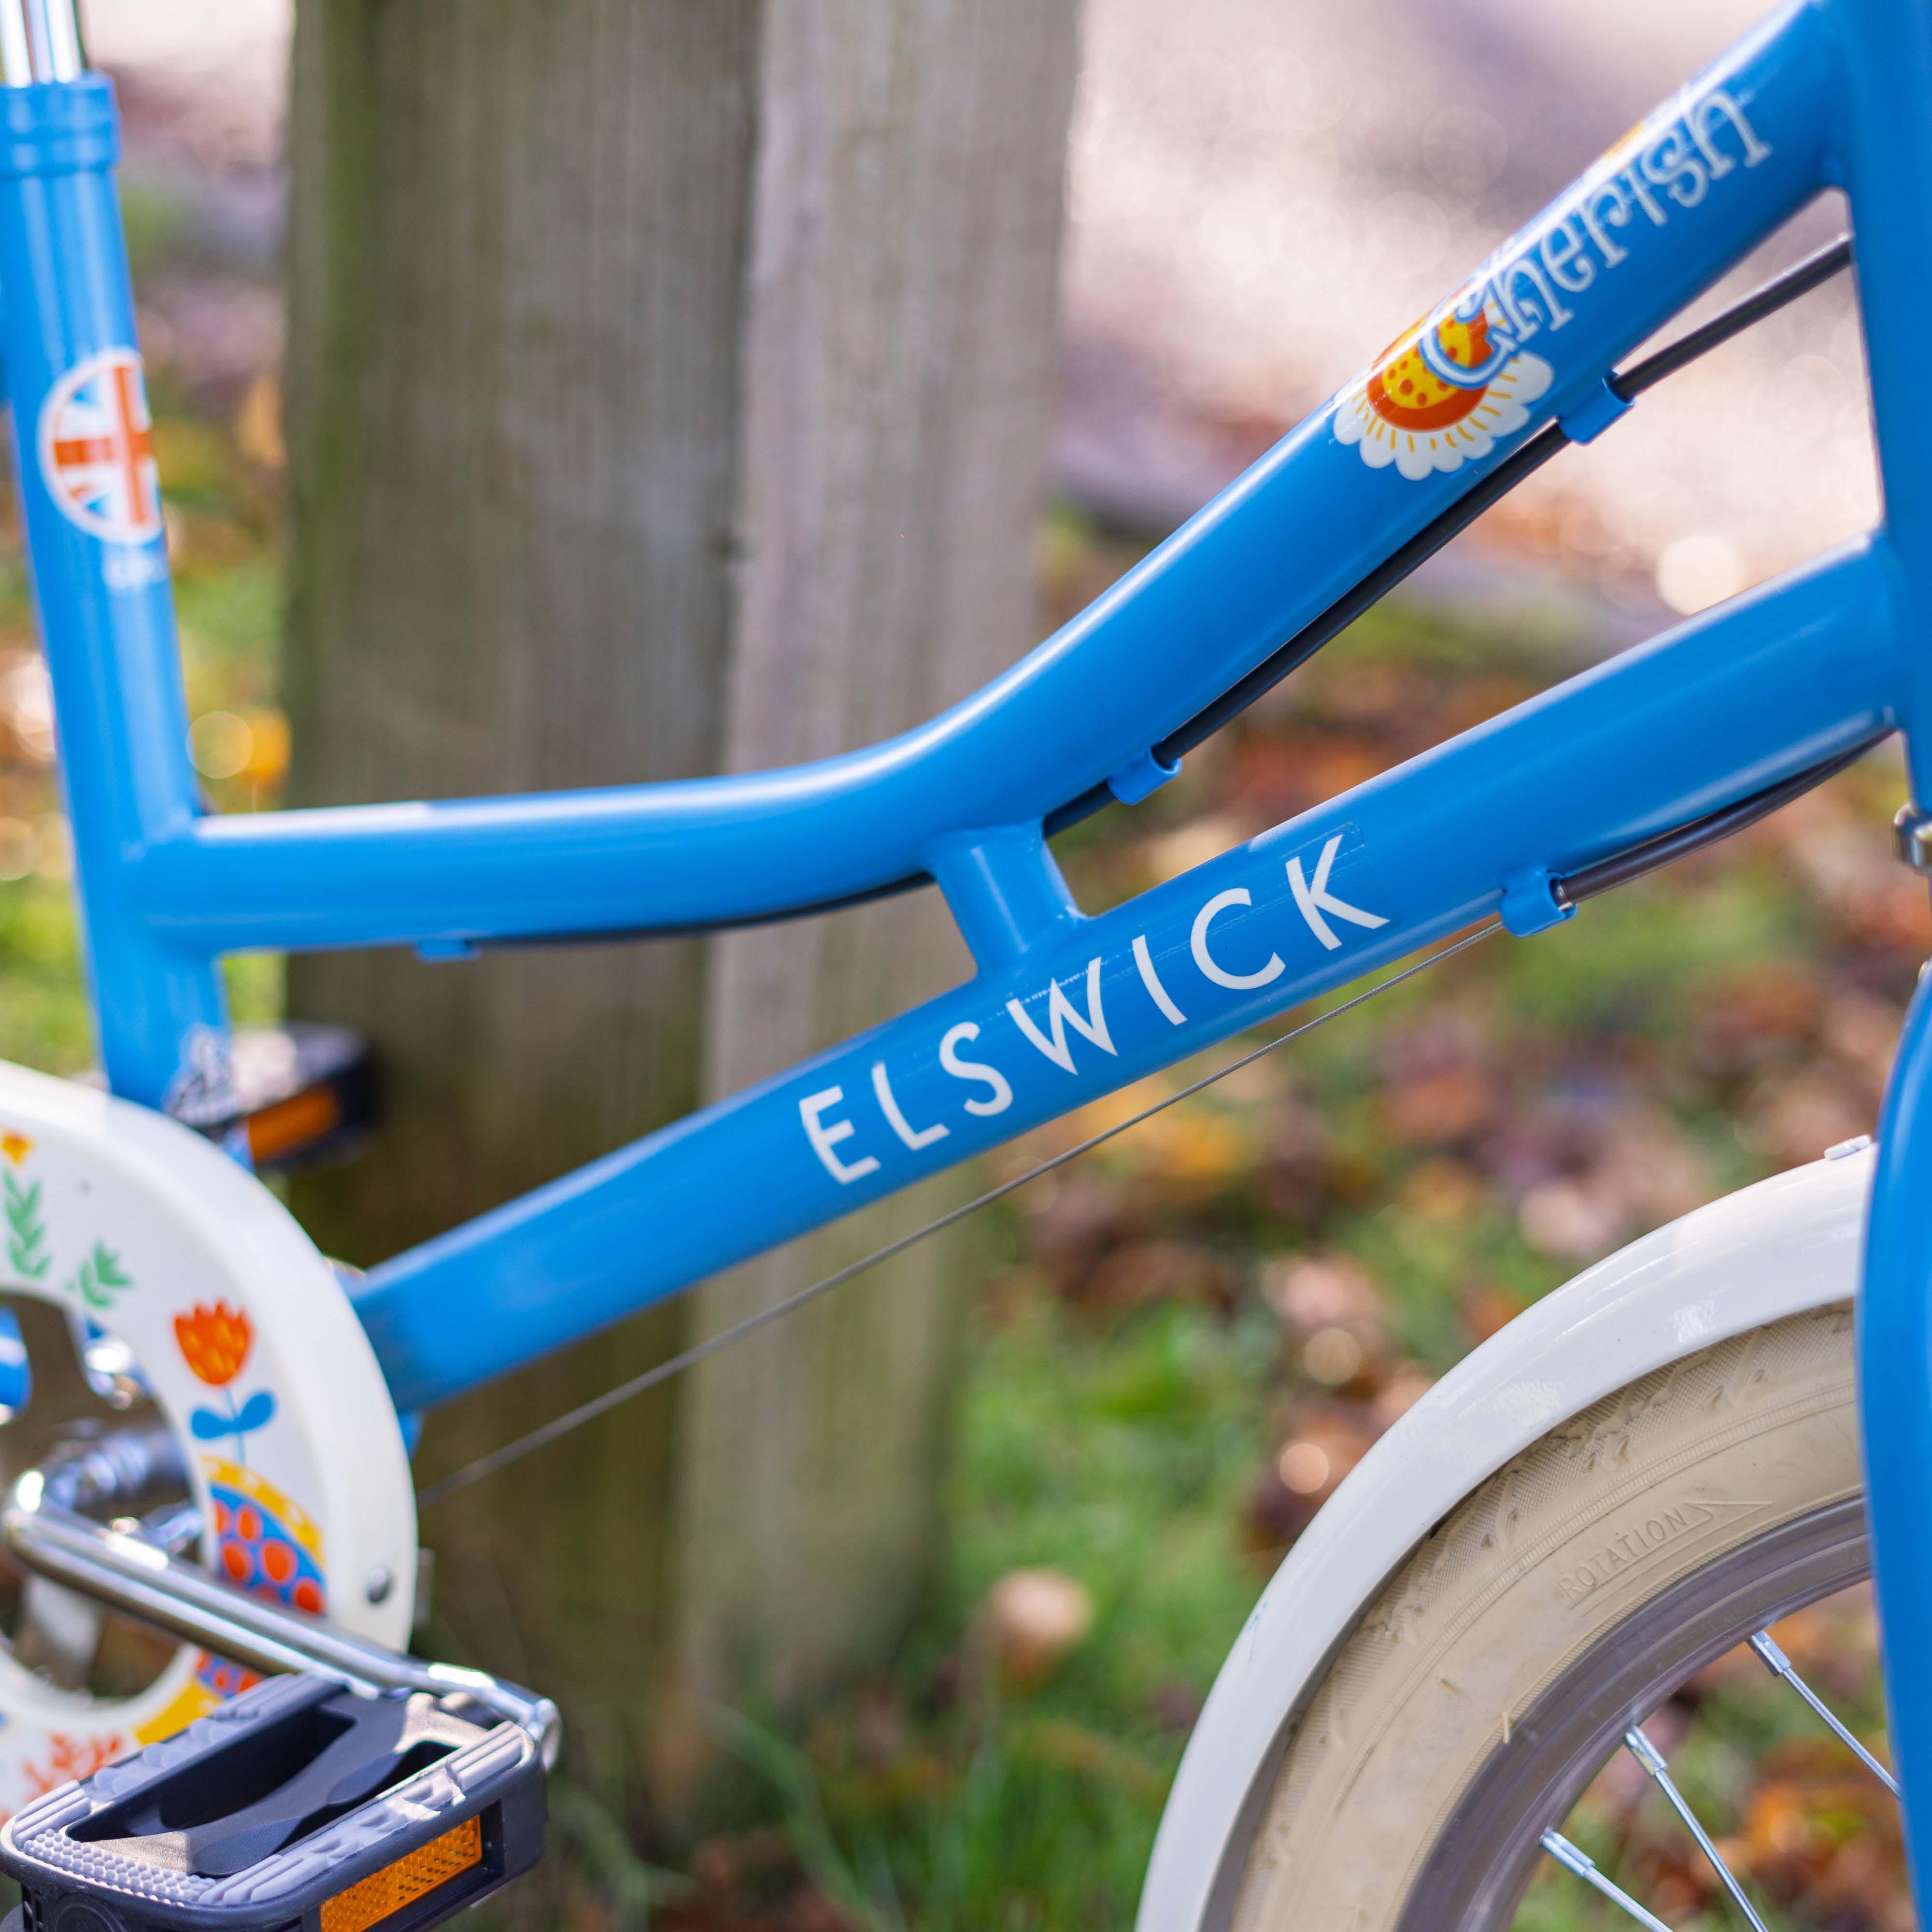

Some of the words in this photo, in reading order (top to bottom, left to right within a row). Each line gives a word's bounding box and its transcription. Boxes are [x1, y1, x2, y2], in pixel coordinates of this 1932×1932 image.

[1419, 83, 1772, 384] Cherish
[799, 834, 1389, 1184] ELSWICK
[1558, 1507, 1686, 1600] ROTATION
